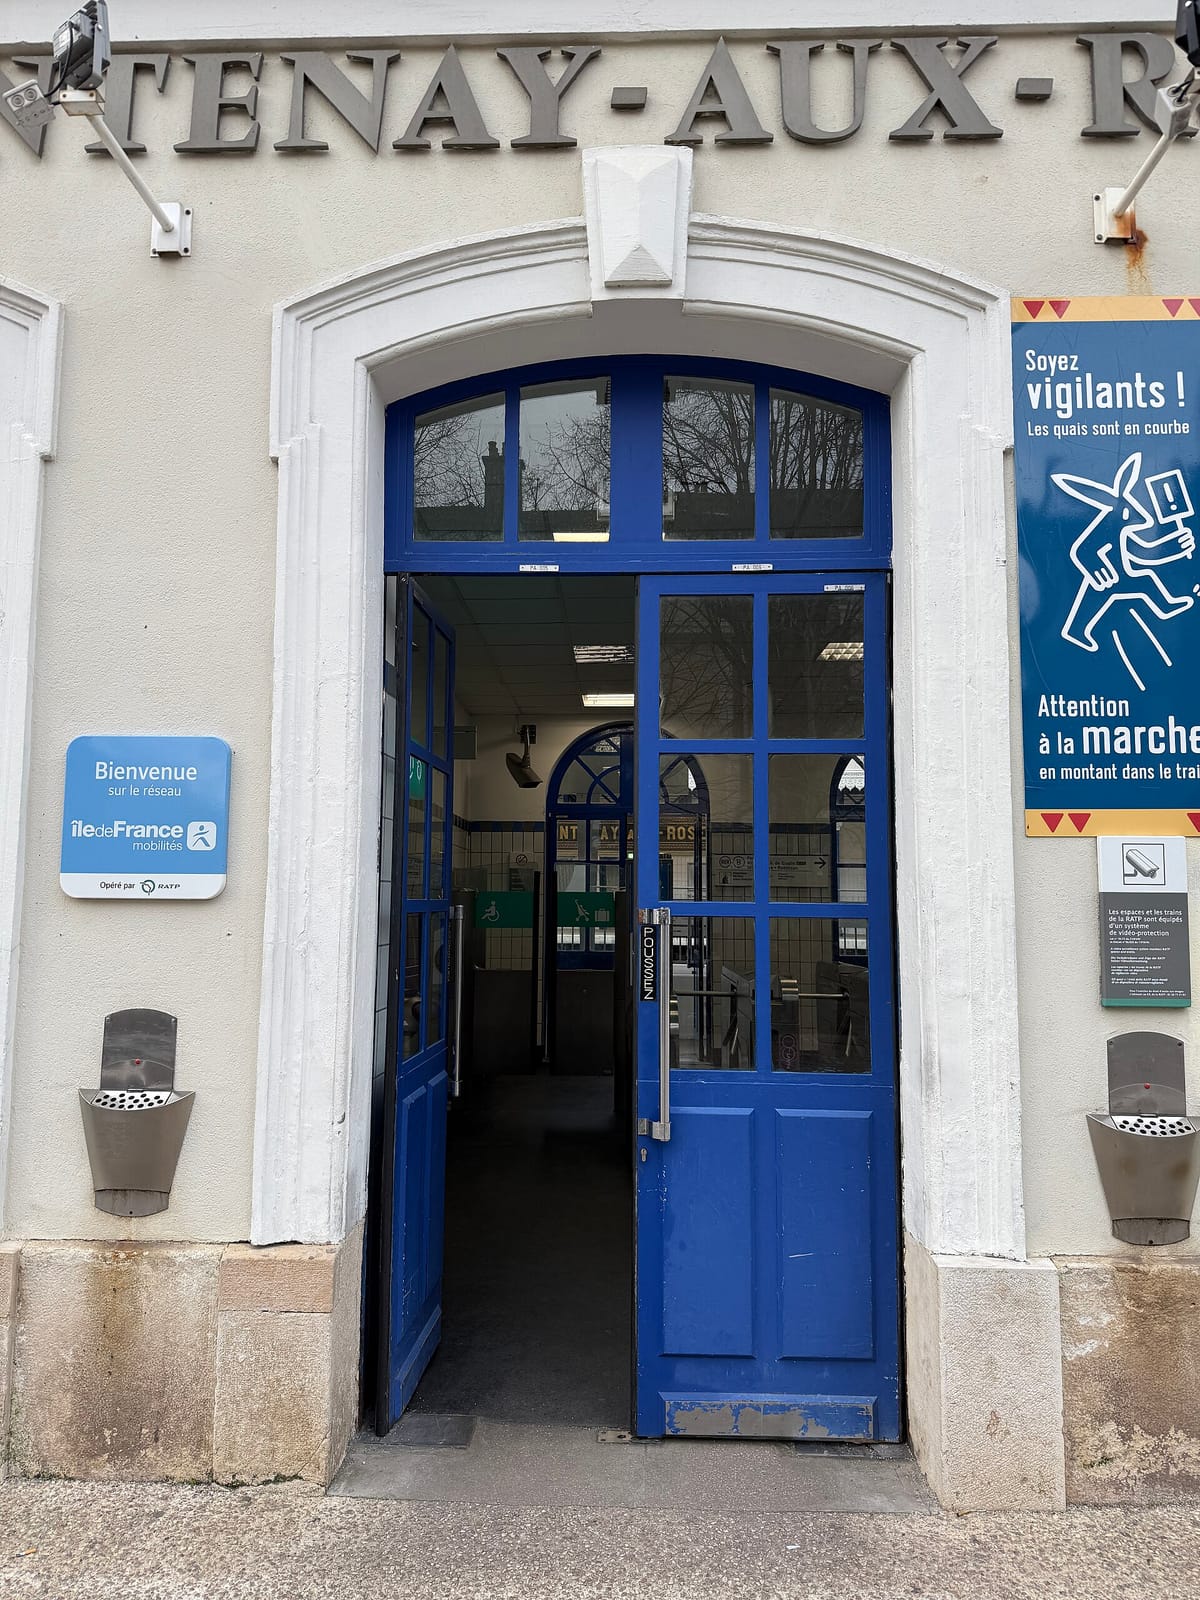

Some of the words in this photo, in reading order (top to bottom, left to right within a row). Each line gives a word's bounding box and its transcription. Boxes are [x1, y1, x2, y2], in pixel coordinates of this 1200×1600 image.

[1025, 349, 1079, 376] Soyez
[1026, 372, 1166, 419] vigilants
[1176, 371, 1185, 408] !
[1027, 421, 1049, 437] Les
[1053, 422, 1088, 439] quais
[1092, 420, 1121, 436] sont
[1124, 423, 1140, 435] en
[1144, 419, 1190, 435] courbe
[1038, 694, 1130, 717] Attention
[1039, 732, 1050, 755] à
[1057, 731, 1075, 755] la
[1082, 715, 1200, 755] marche
[95, 761, 198, 781] Bienvenue
[1039, 766, 1056, 780] en
[1060, 763, 1118, 780] montant
[1122, 763, 1155, 780] dans
[1159, 763, 1172, 780] le
[108, 785, 127, 796] sur
[129, 784, 140, 796] le
[143, 784, 182, 797] réseau
[132, 839, 183, 851] mobilités
[99, 880, 122, 891] Opéré
[123, 882, 136, 891] par
[1124, 922, 1150, 930] système
[1158, 916, 1183, 924] équipés
[643, 927, 654, 1000] POUSSEZ
